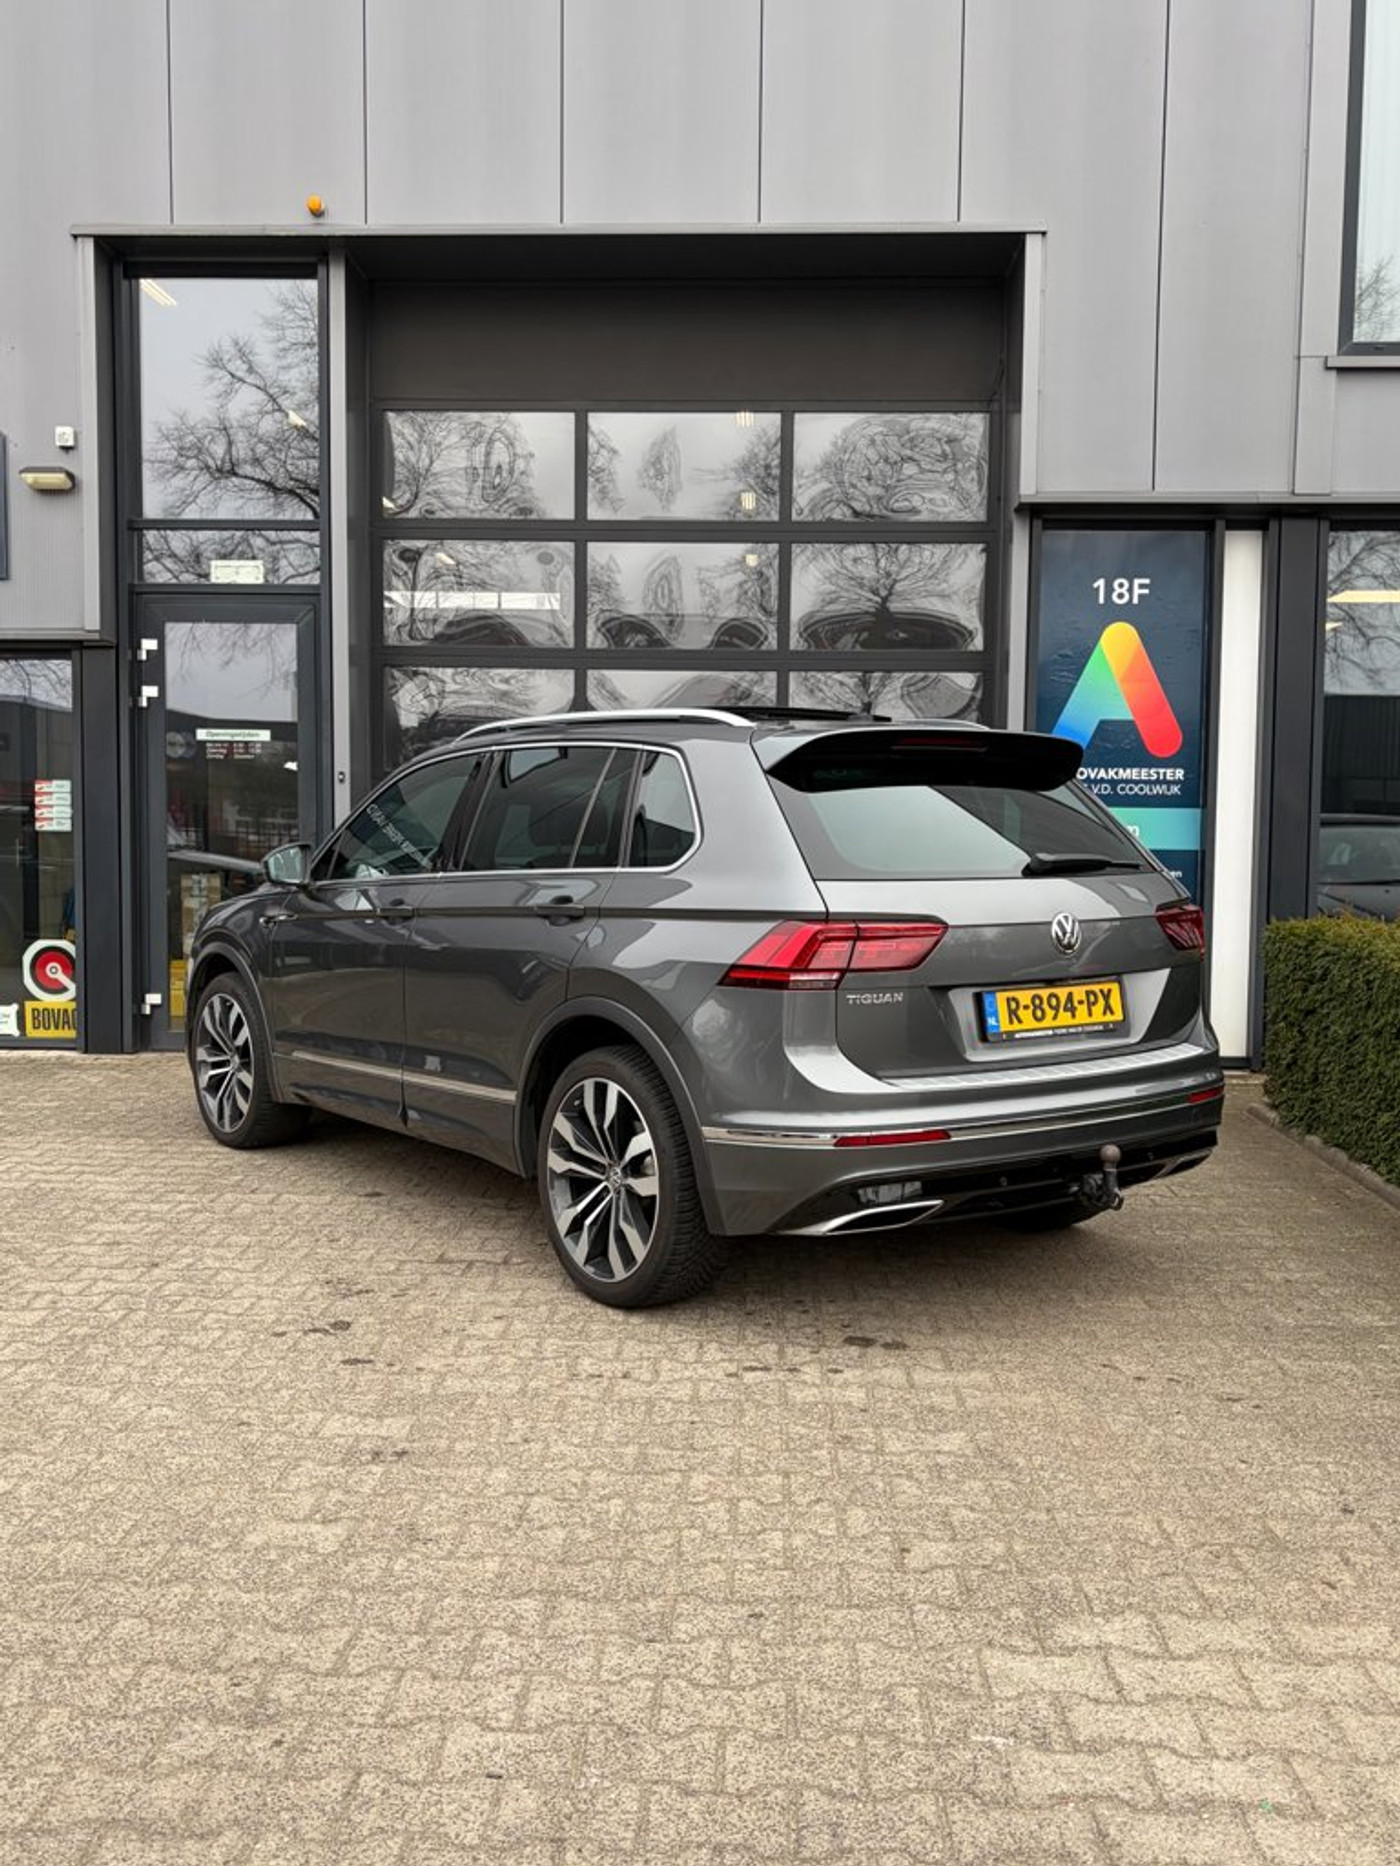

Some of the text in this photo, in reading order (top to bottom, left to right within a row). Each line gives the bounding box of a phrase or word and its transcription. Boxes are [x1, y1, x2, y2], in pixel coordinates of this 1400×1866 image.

[1093, 578, 1150, 604] 18F
[1116, 784, 1182, 796] COOLWIJK
[846, 991, 904, 1005] TIGUAN
[1006, 988, 1115, 1026] R-894-PX
[986, 1017, 998, 1026] NL
